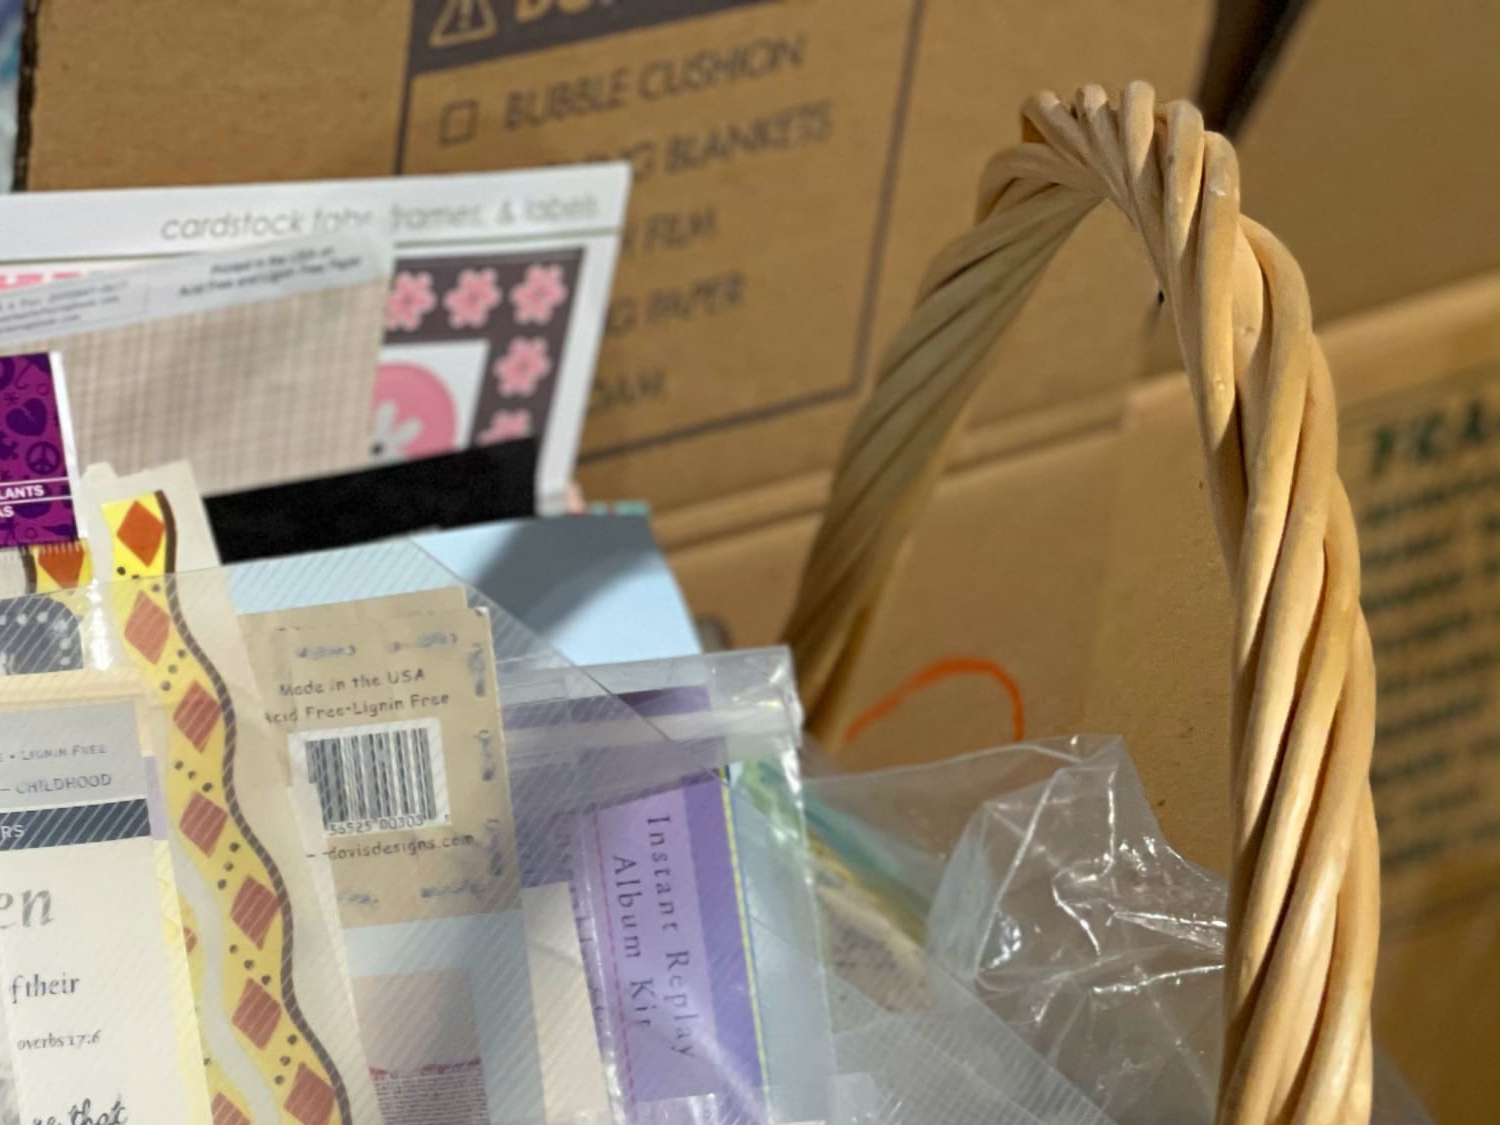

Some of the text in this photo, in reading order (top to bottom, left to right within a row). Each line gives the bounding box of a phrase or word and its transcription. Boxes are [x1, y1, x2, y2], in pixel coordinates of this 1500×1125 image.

[505, 34, 807, 130] BUBBLE CUSHION
[664, 101, 832, 175] BLANKETS
[161, 211, 300, 241] cardstock
[280, 668, 425, 697] Made in the USA
[410, 694, 450, 708] Free
[16, 773, 113, 796] CHILDHOOD
[612, 854, 658, 1027] Album Kit
[647, 814, 699, 1059] Instant Replay
